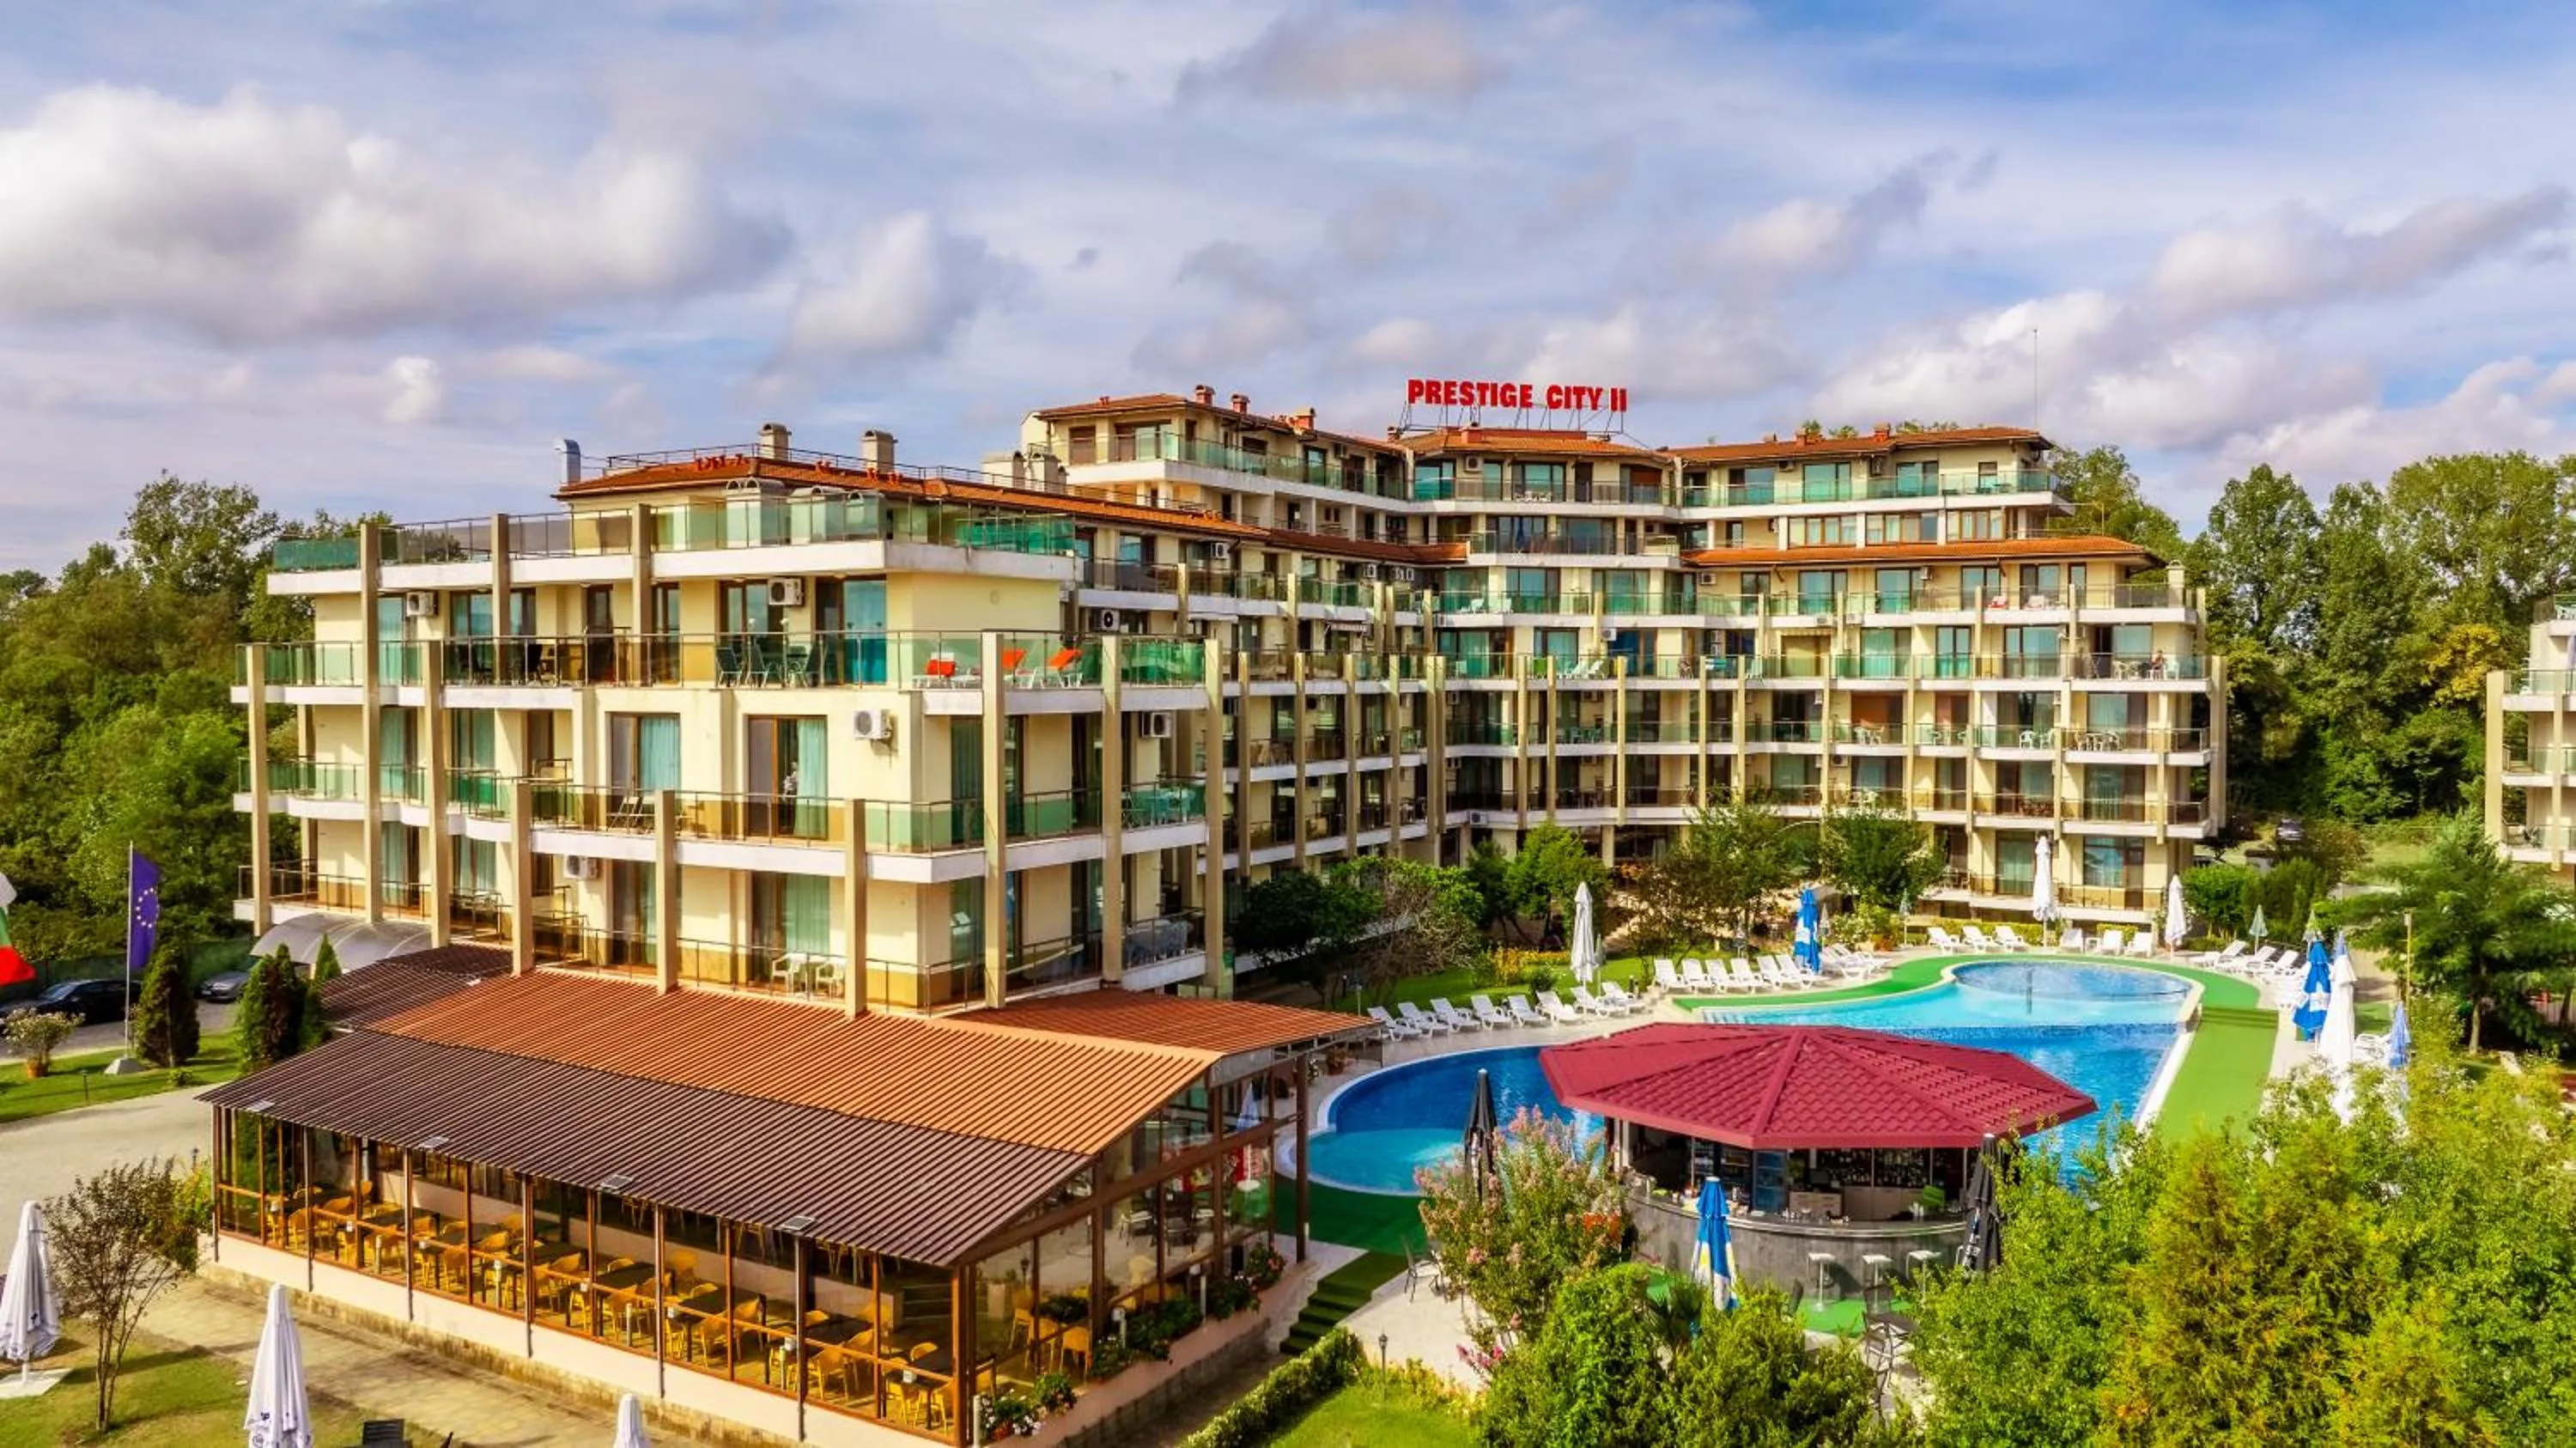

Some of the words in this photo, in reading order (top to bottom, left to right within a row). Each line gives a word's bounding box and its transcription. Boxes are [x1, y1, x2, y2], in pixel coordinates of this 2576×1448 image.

[1406, 378, 1534, 410] PRESTIGE
[1545, 383, 1604, 411] CITY
[1609, 386, 1628, 412] II
